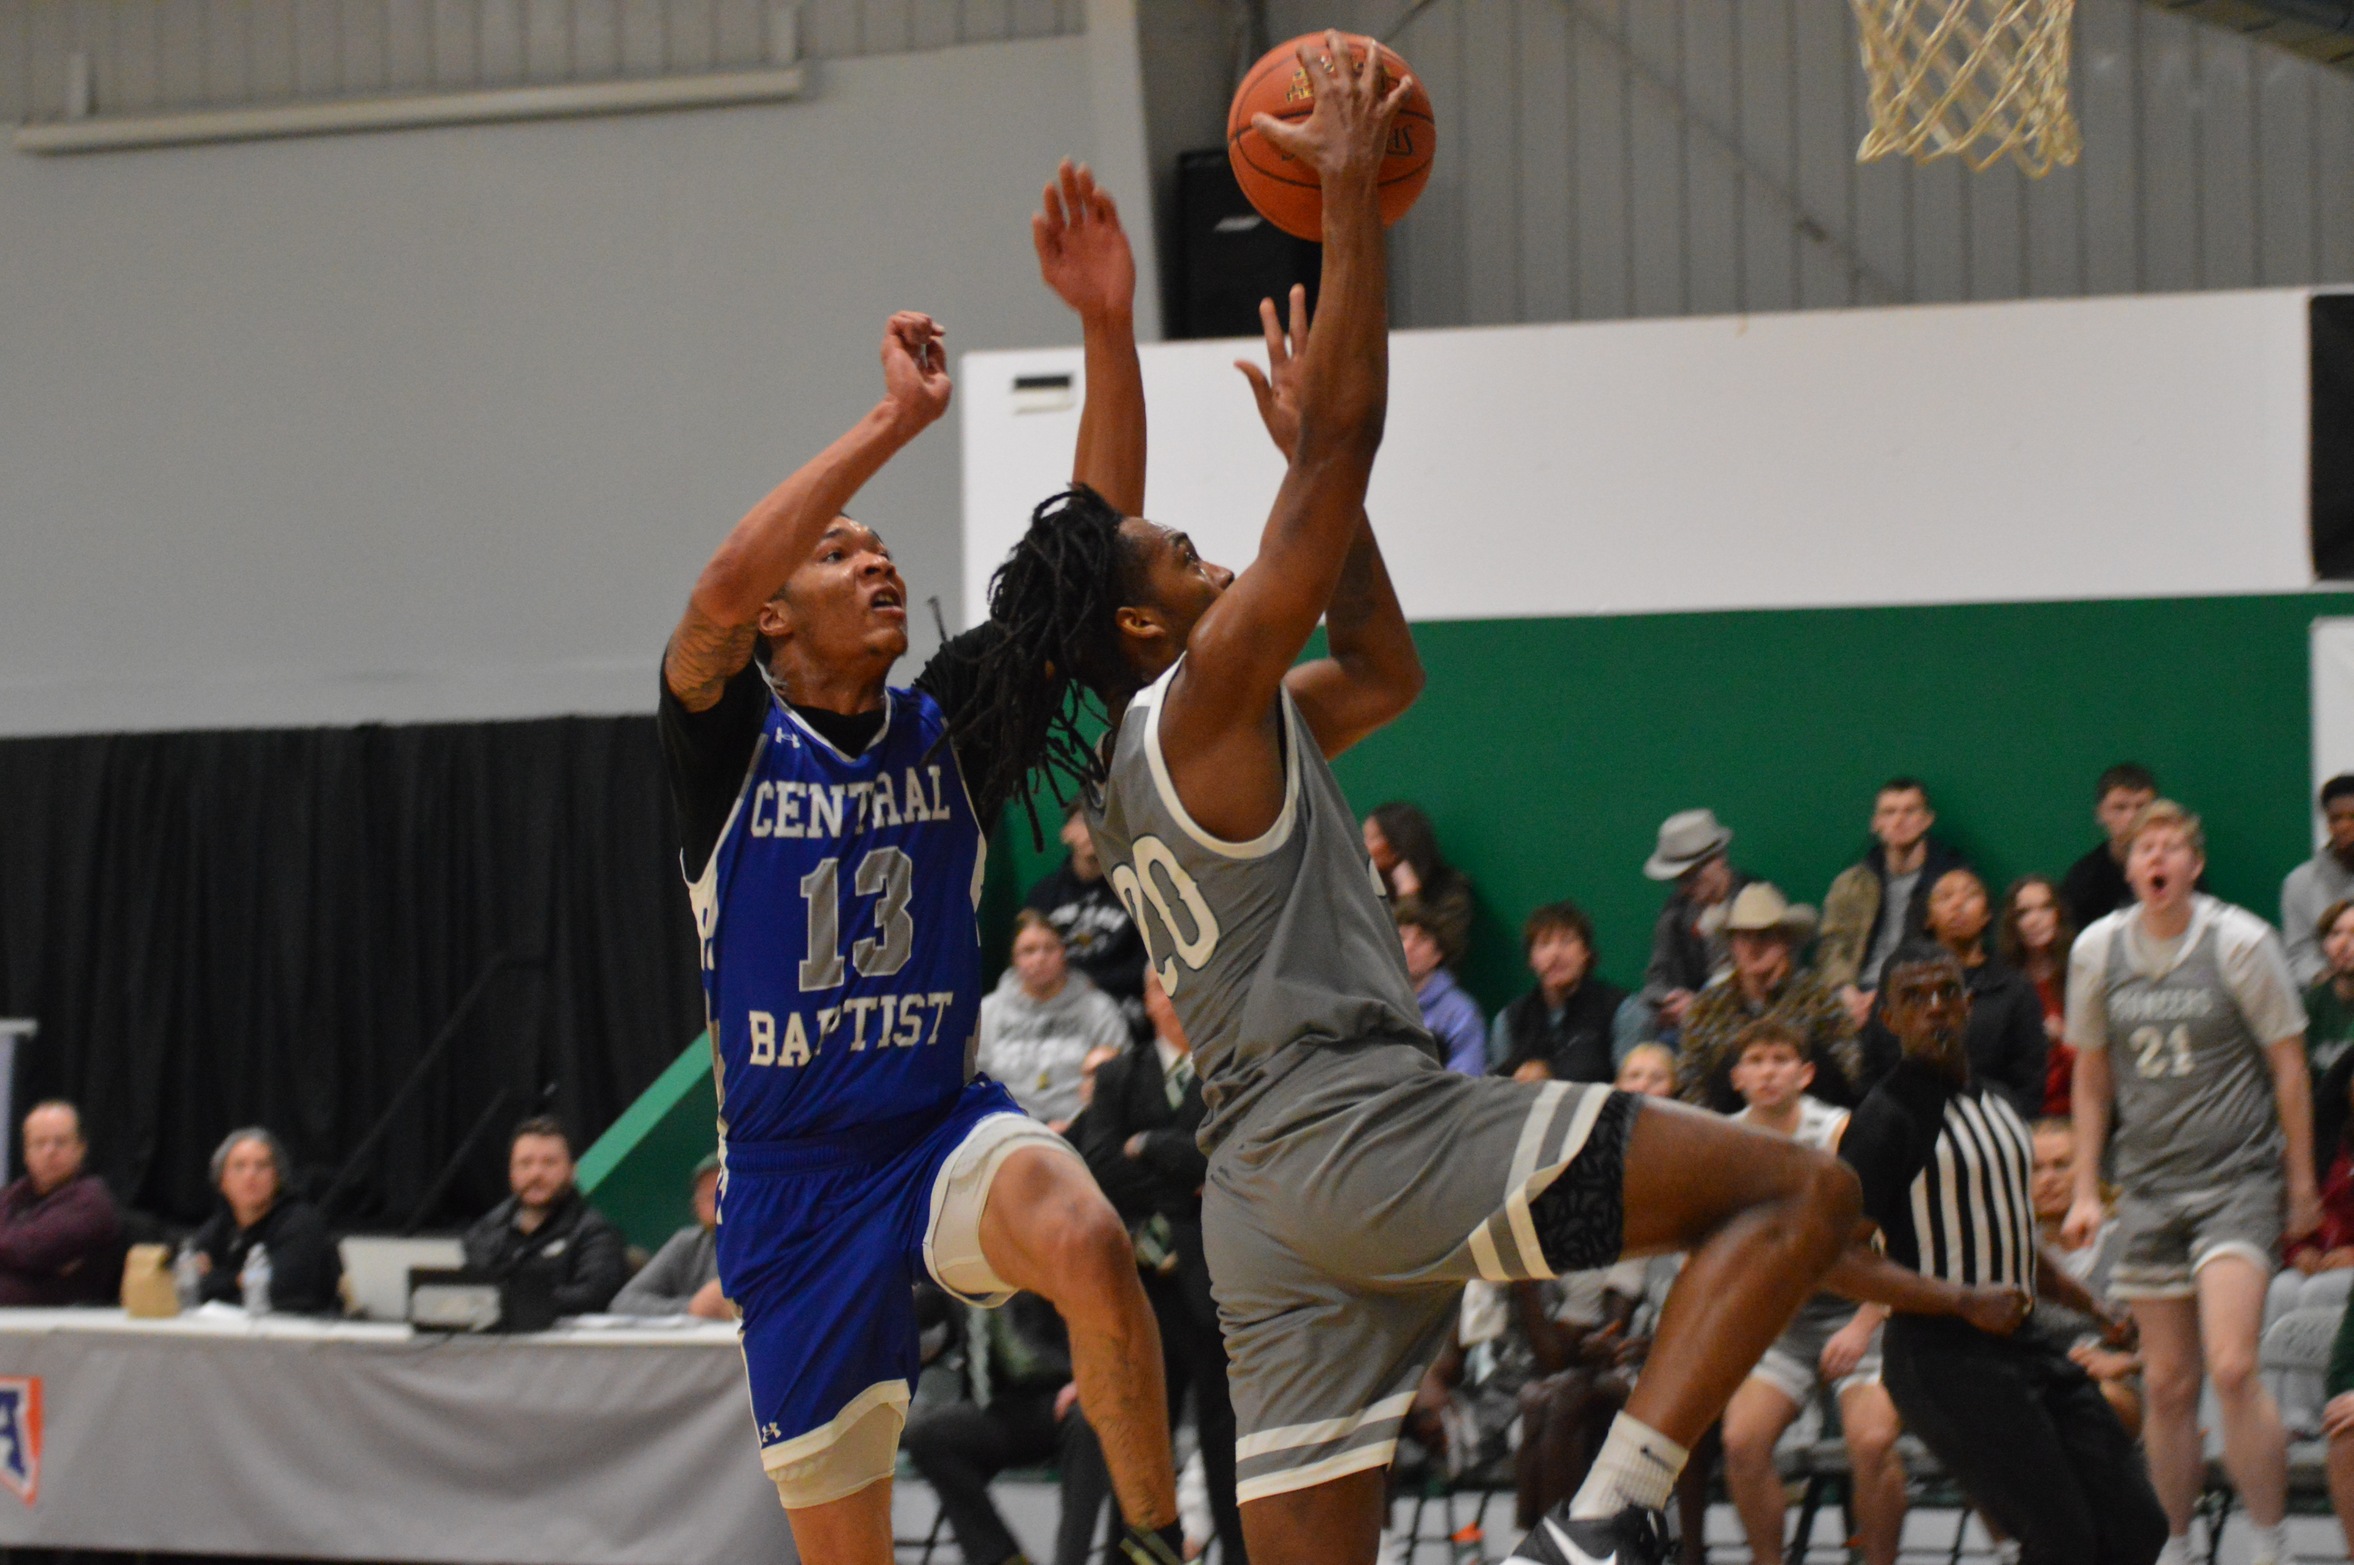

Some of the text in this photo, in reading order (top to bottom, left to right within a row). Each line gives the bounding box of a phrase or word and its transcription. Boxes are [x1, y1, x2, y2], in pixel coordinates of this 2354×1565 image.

[751, 765, 950, 839] CENTRAL
[799, 846, 913, 992] 13
[748, 991, 954, 1068] BAPTIST
[2128, 1023, 2196, 1080] 21
